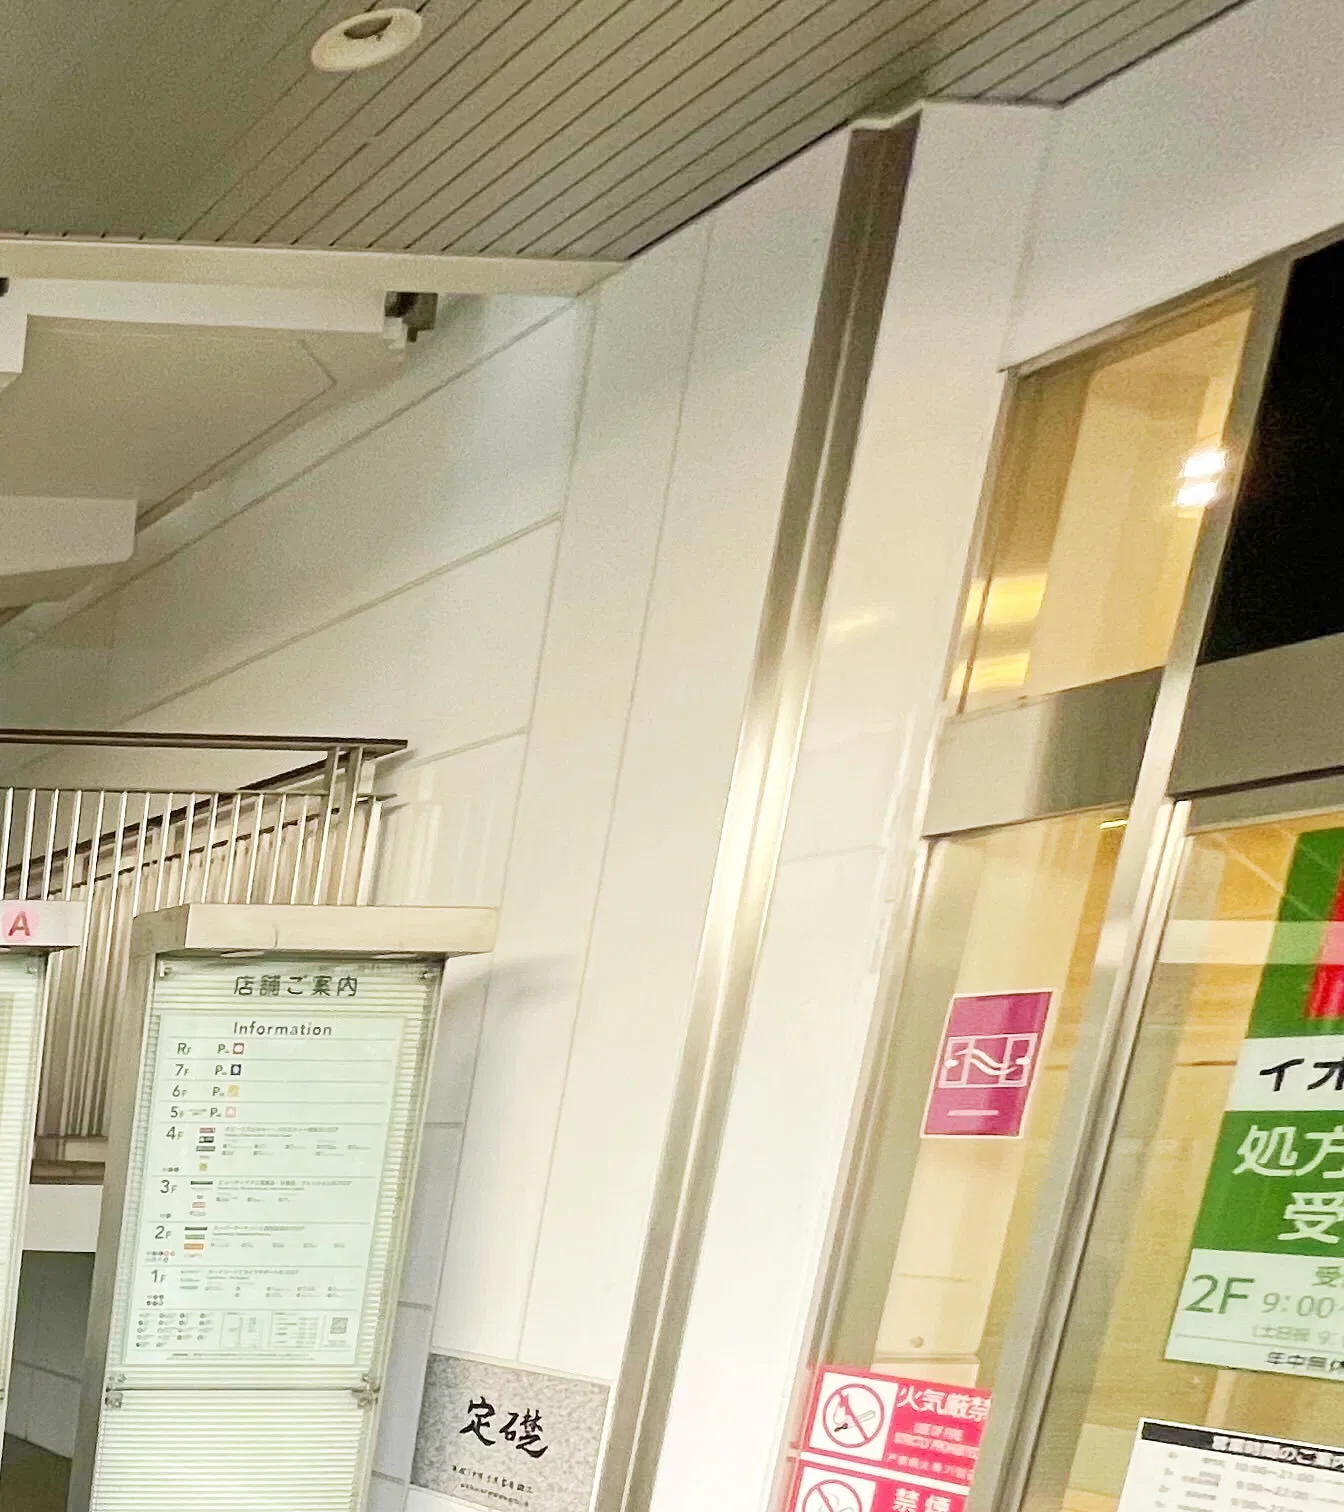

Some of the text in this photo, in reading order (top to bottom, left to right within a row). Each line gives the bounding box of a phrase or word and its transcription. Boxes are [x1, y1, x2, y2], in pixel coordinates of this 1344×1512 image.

[7, 910, 32, 937] A
[233, 975, 359, 997] 店舗ご案内
[233, 1021, 333, 1037] Information
[1184, 1274, 1255, 1316] 2F
[897, 1384, 991, 1422] 火気厳禁
[459, 1396, 549, 1459] 定礎
